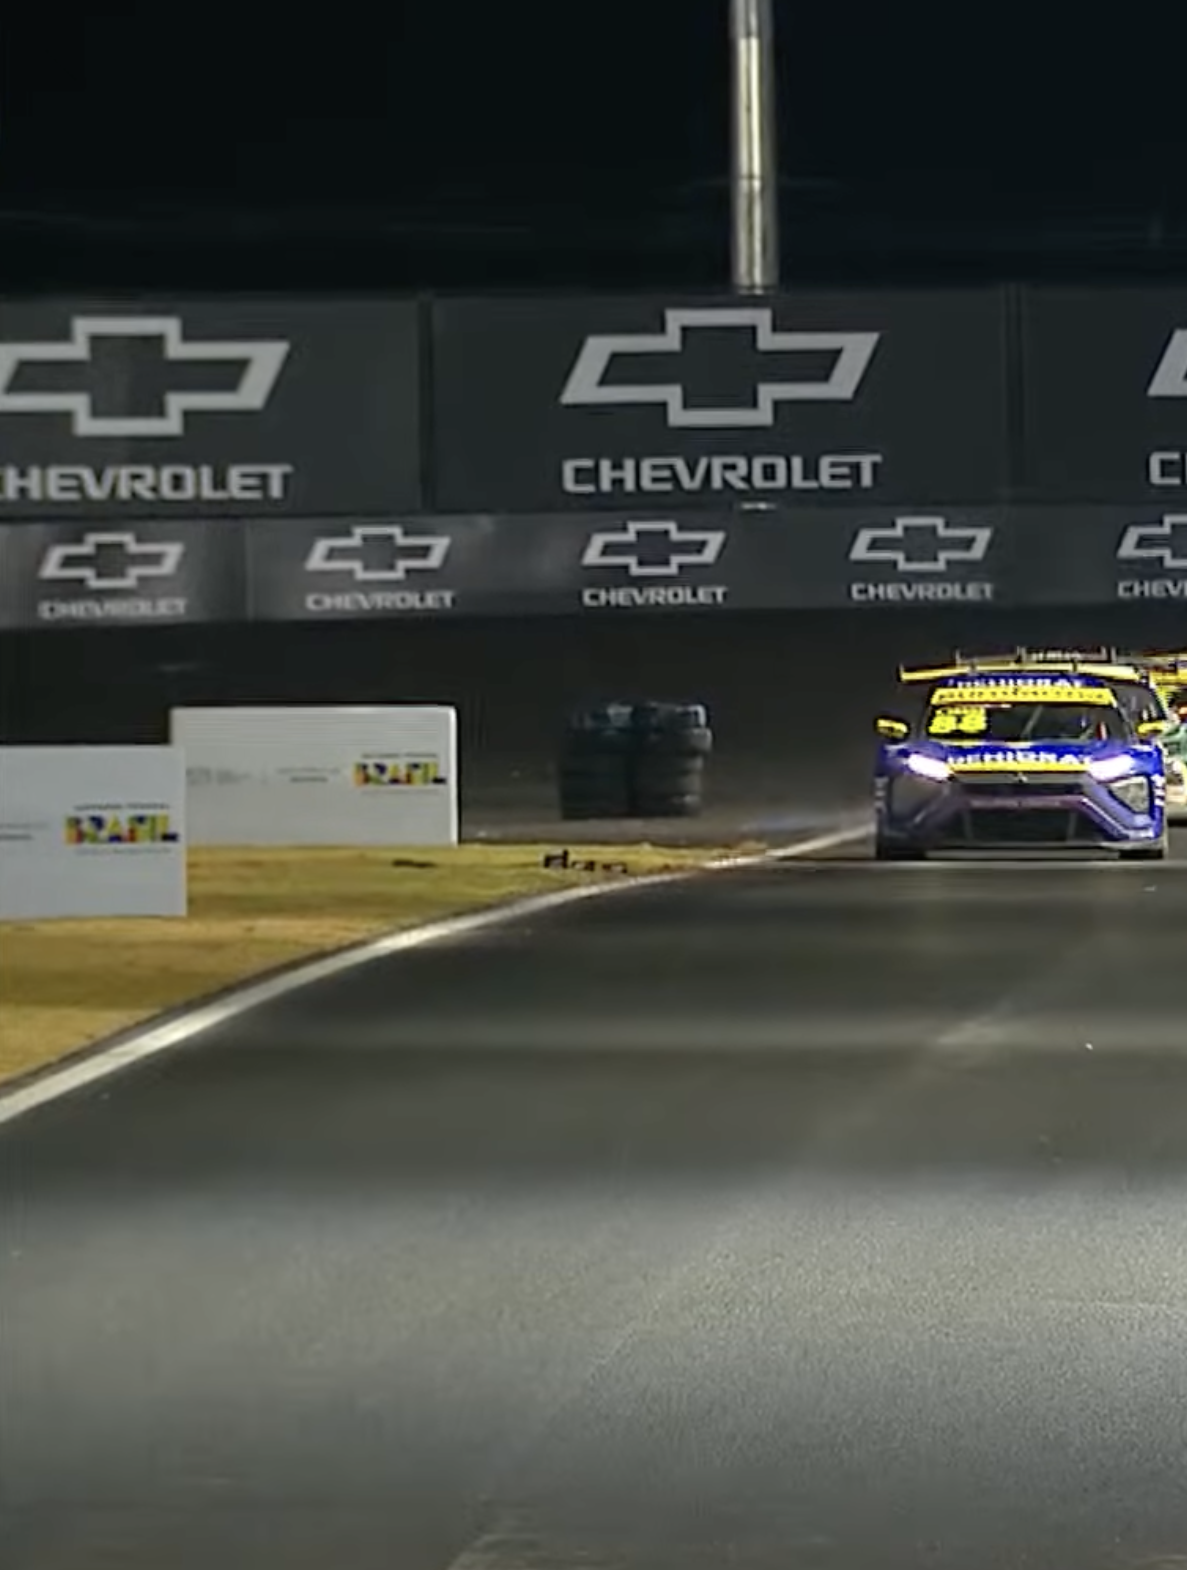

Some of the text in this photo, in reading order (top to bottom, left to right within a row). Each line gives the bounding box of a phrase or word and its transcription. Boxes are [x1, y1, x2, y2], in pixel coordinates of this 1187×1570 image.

[0, 465, 291, 500] HEVROLET
[561, 454, 883, 494] CHEVROLET
[304, 590, 454, 612] CHEVROLET
[582, 586, 727, 607] CHEVROLET
[850, 582, 993, 603] CHEVROLET
[37, 597, 188, 620] CHEVROLET
